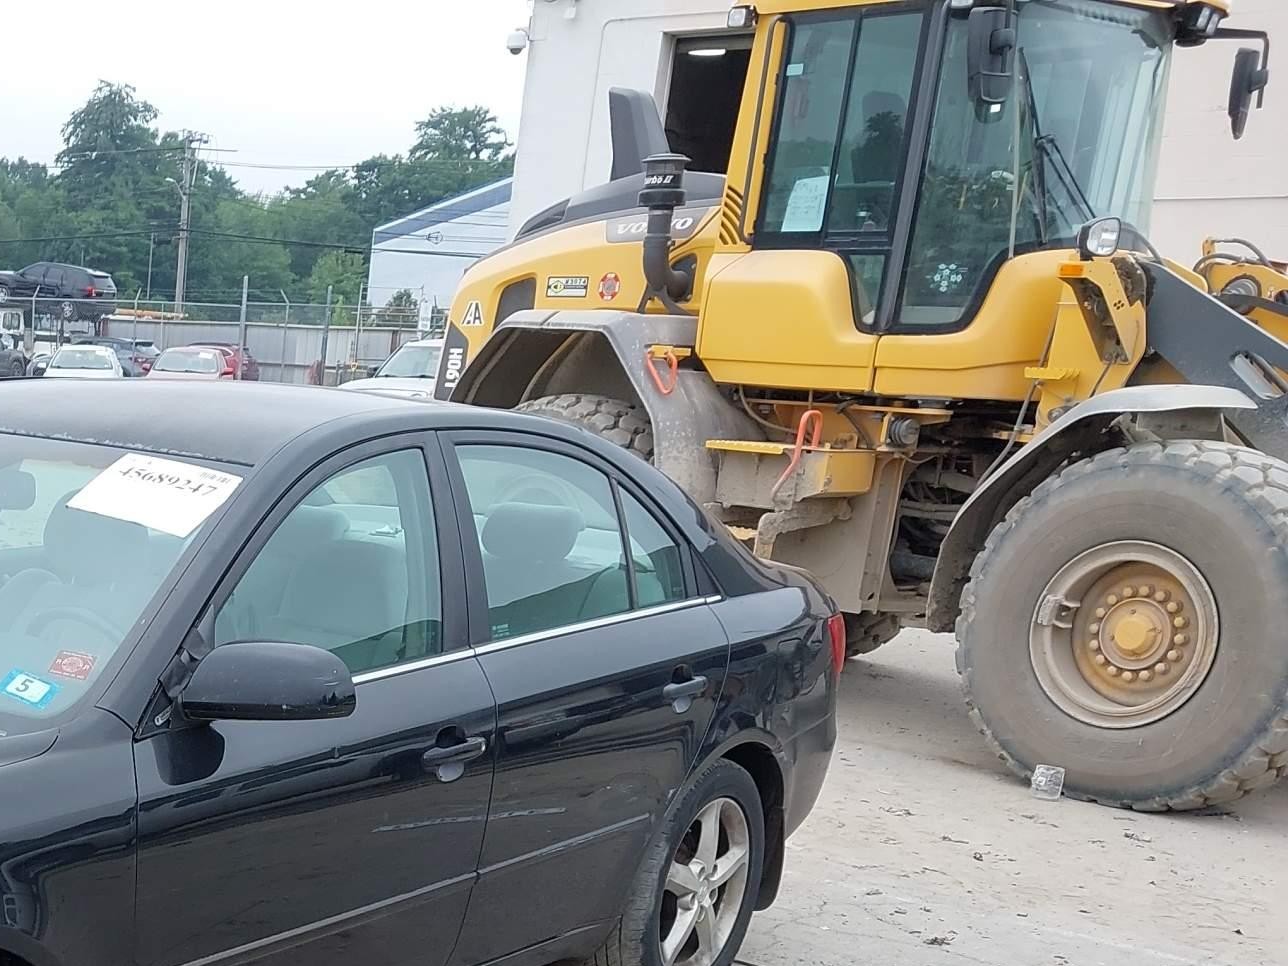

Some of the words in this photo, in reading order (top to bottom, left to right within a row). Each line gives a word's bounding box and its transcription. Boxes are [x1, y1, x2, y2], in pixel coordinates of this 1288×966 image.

[616, 217, 694, 235] VOO
[444, 347, 464, 388] L90H
[118, 465, 218, 497] 45689247
[14, 678, 34, 693] 5
